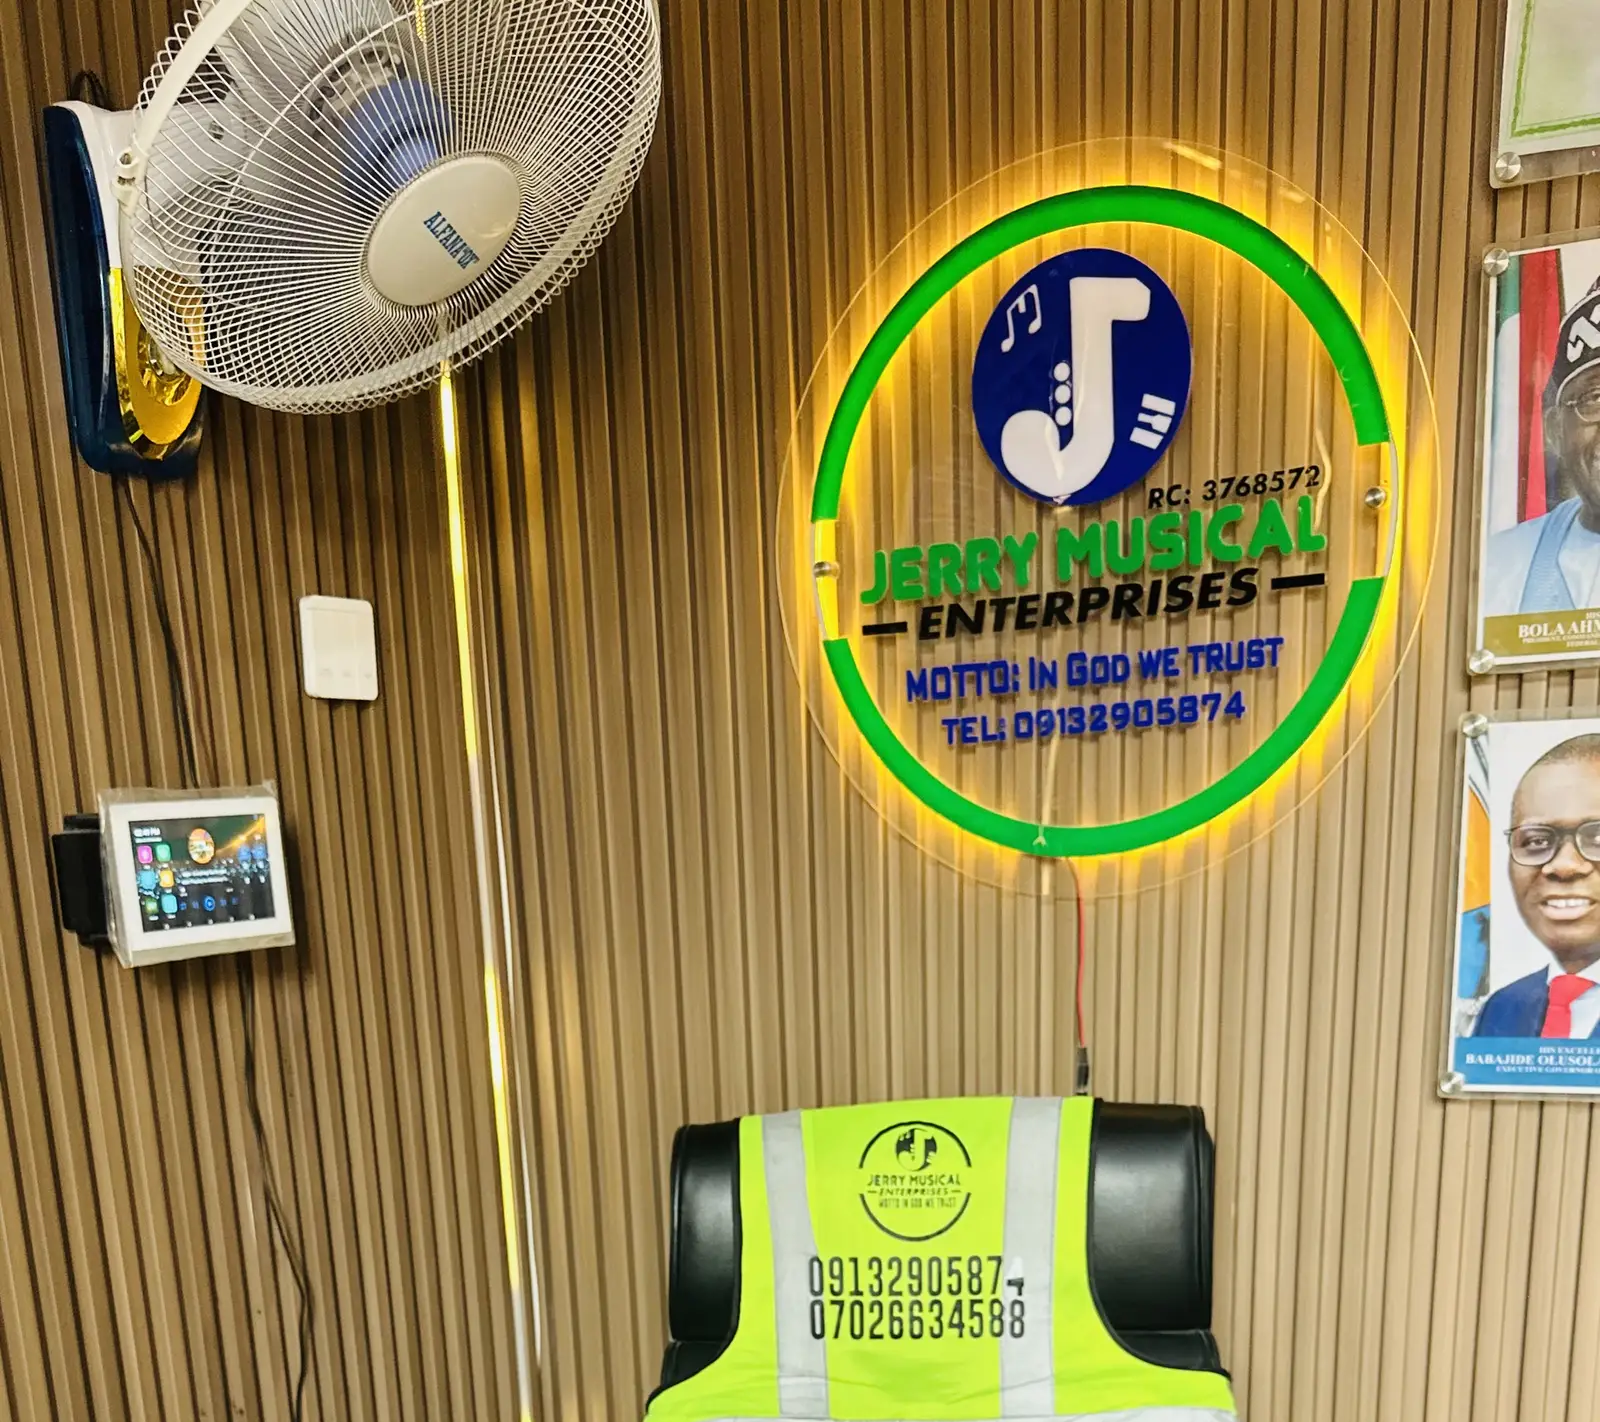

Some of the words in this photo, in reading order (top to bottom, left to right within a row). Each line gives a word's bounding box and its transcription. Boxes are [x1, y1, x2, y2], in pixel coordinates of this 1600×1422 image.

[1148, 484, 1191, 509] RC:
[1202, 465, 1320, 501] 3768572
[860, 531, 1039, 605] JERRY
[1056, 494, 1328, 583] MUSICAL
[918, 567, 1259, 640] ENTERPRISES
[1518, 621, 1565, 638] BOLA
[906, 659, 1020, 702] MOTTO:
[1028, 656, 1058, 690] IN
[1066, 651, 1131, 687] GOD
[1138, 646, 1180, 680] WE
[1186, 636, 1284, 676] TRUST
[941, 715, 1006, 745] TEL:
[1013, 690, 1246, 740] 09132905874
[1466, 1053, 1535, 1065] BABAJIDE
[867, 1174, 905, 1187] JERRY
[909, 1174, 961, 1187] MUSICAL
[879, 1187, 949, 1197] ENTERPRISES
[810, 1299, 1025, 1340] 07026634588
